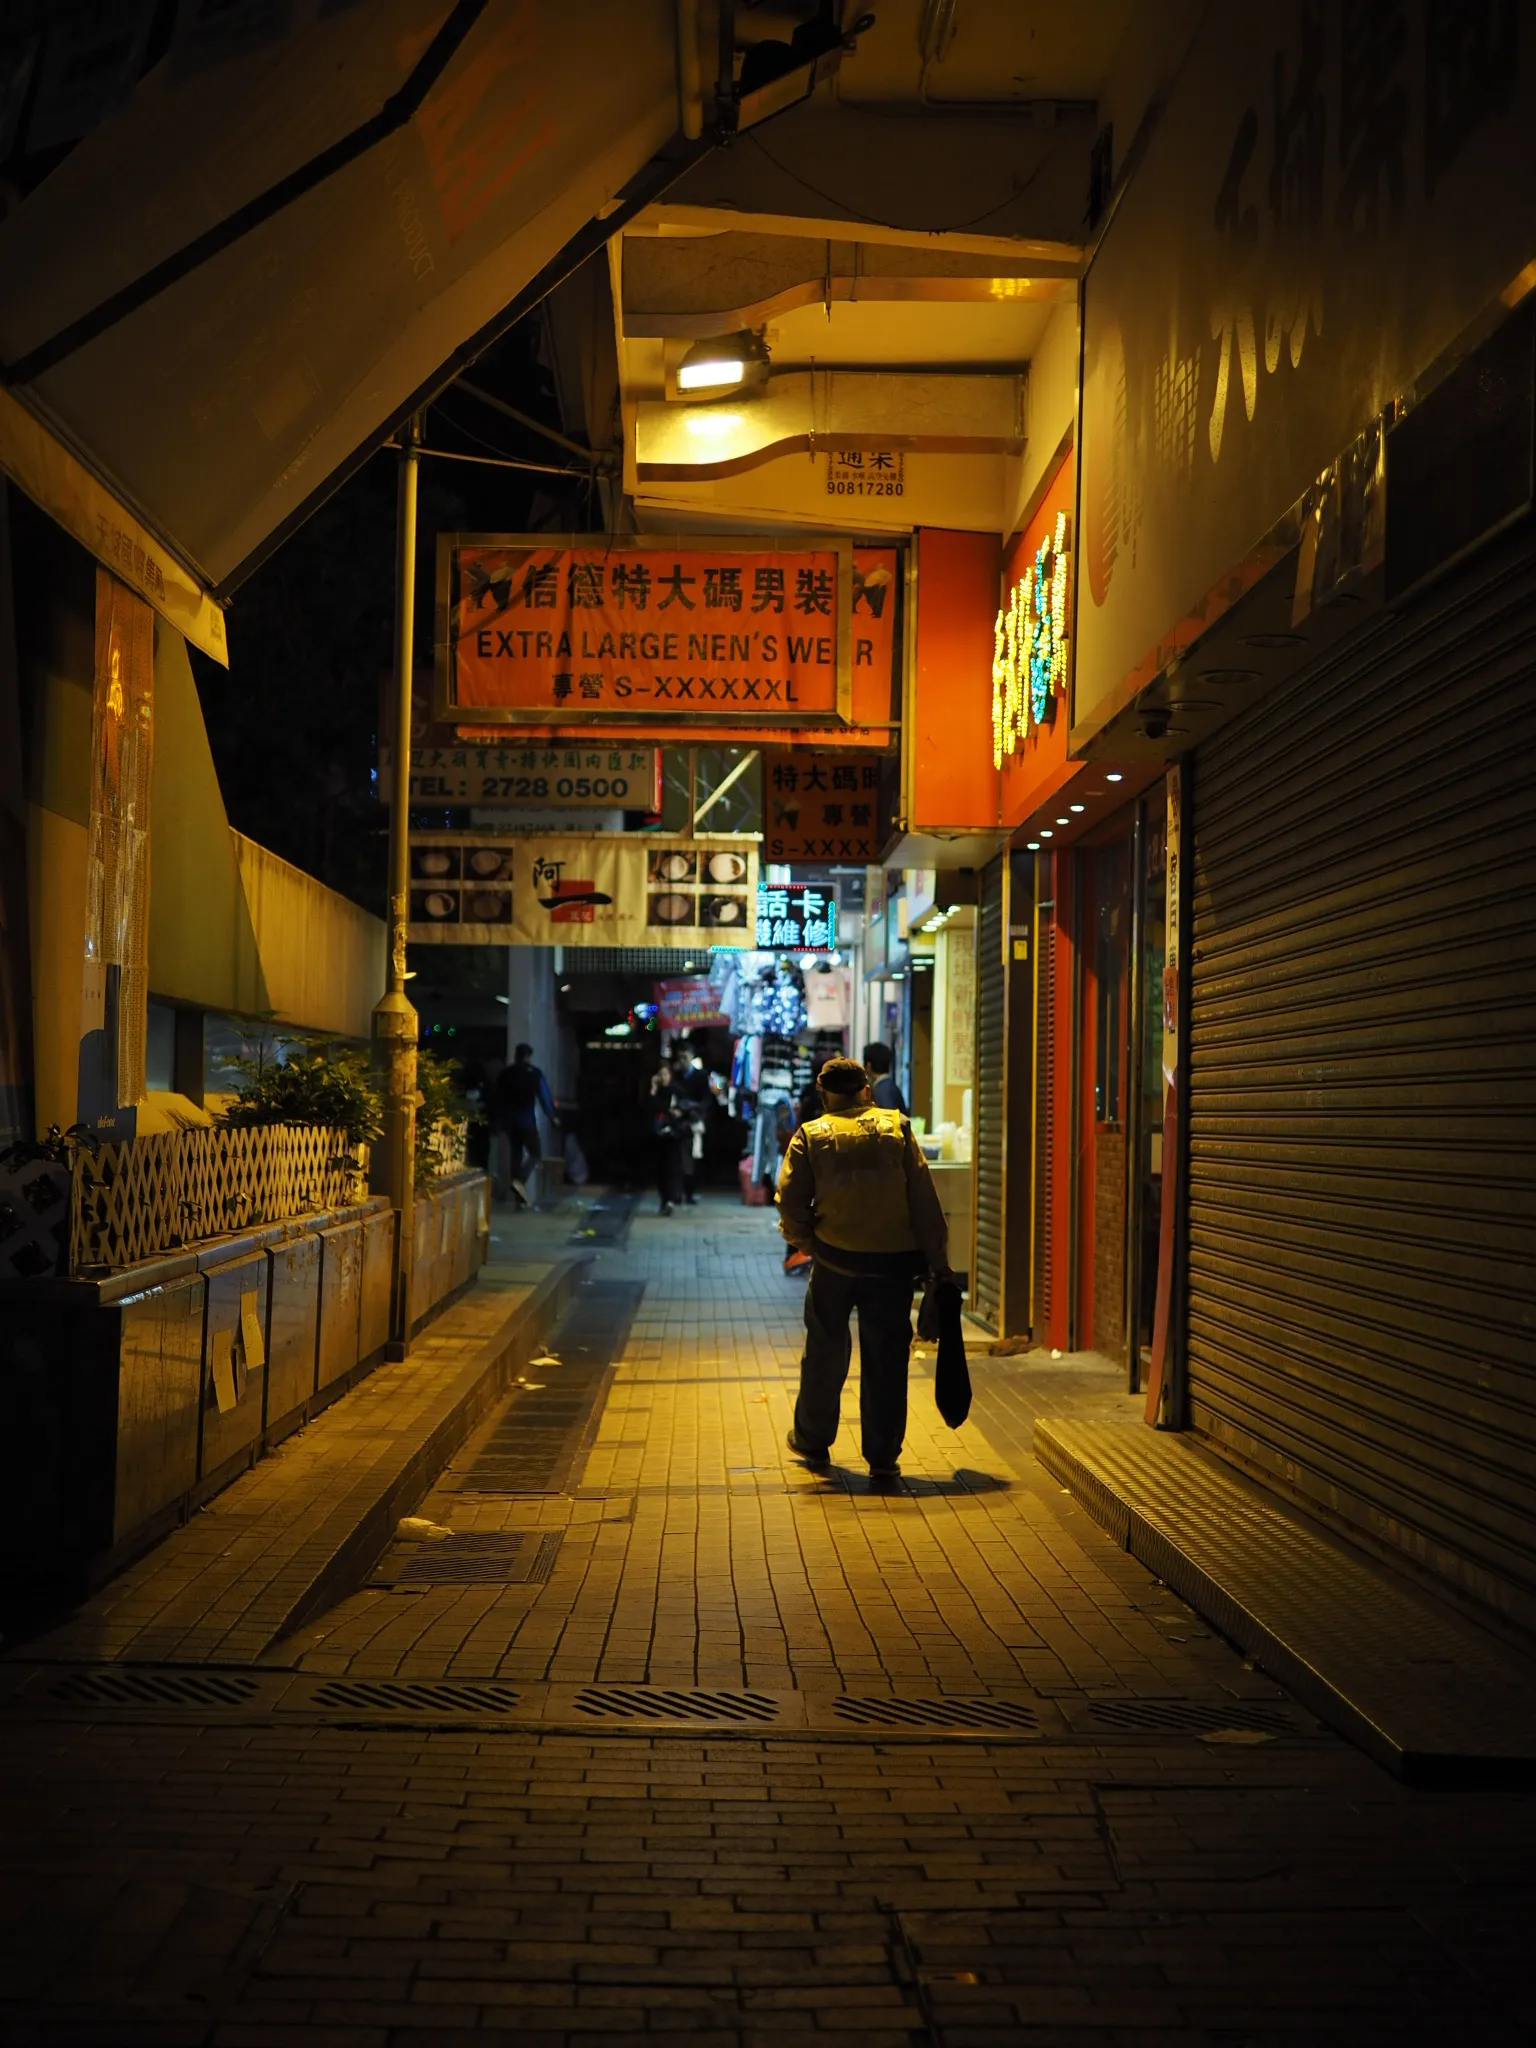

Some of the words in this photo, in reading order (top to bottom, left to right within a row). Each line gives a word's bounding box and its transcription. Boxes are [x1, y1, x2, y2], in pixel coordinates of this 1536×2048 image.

[827, 482, 904, 496] 90817280
[523, 563, 835, 615] 信德特大碼男裝
[477, 629, 573, 659] EXTRA
[582, 631, 679, 661] LARGE
[786, 636, 874, 667] WER
[552, 672, 604, 699] 專營
[614, 675, 799, 703] S-XXXXXXL
[481, 776, 549, 798] 2728
[556, 777, 629, 799] 0500
[770, 837, 877, 857] S-XXXX
